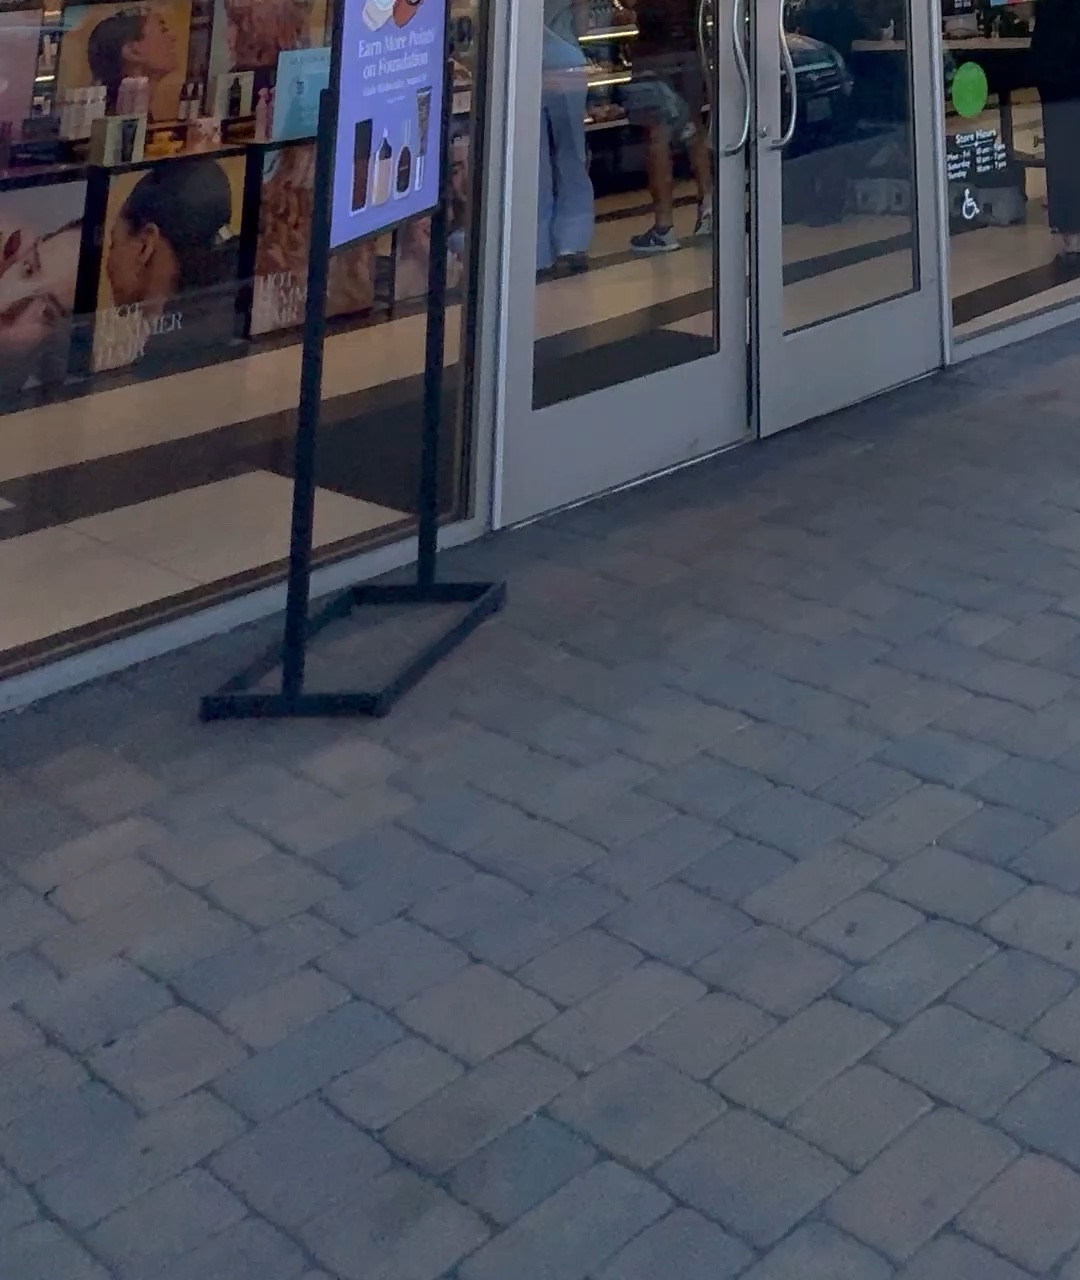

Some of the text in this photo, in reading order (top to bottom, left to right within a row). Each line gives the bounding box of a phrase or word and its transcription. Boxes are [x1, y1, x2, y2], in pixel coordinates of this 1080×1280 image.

[358, 40, 382, 58] Earn
[362, 64, 376, 80] on
[955, 129, 996, 144] Store Hours
